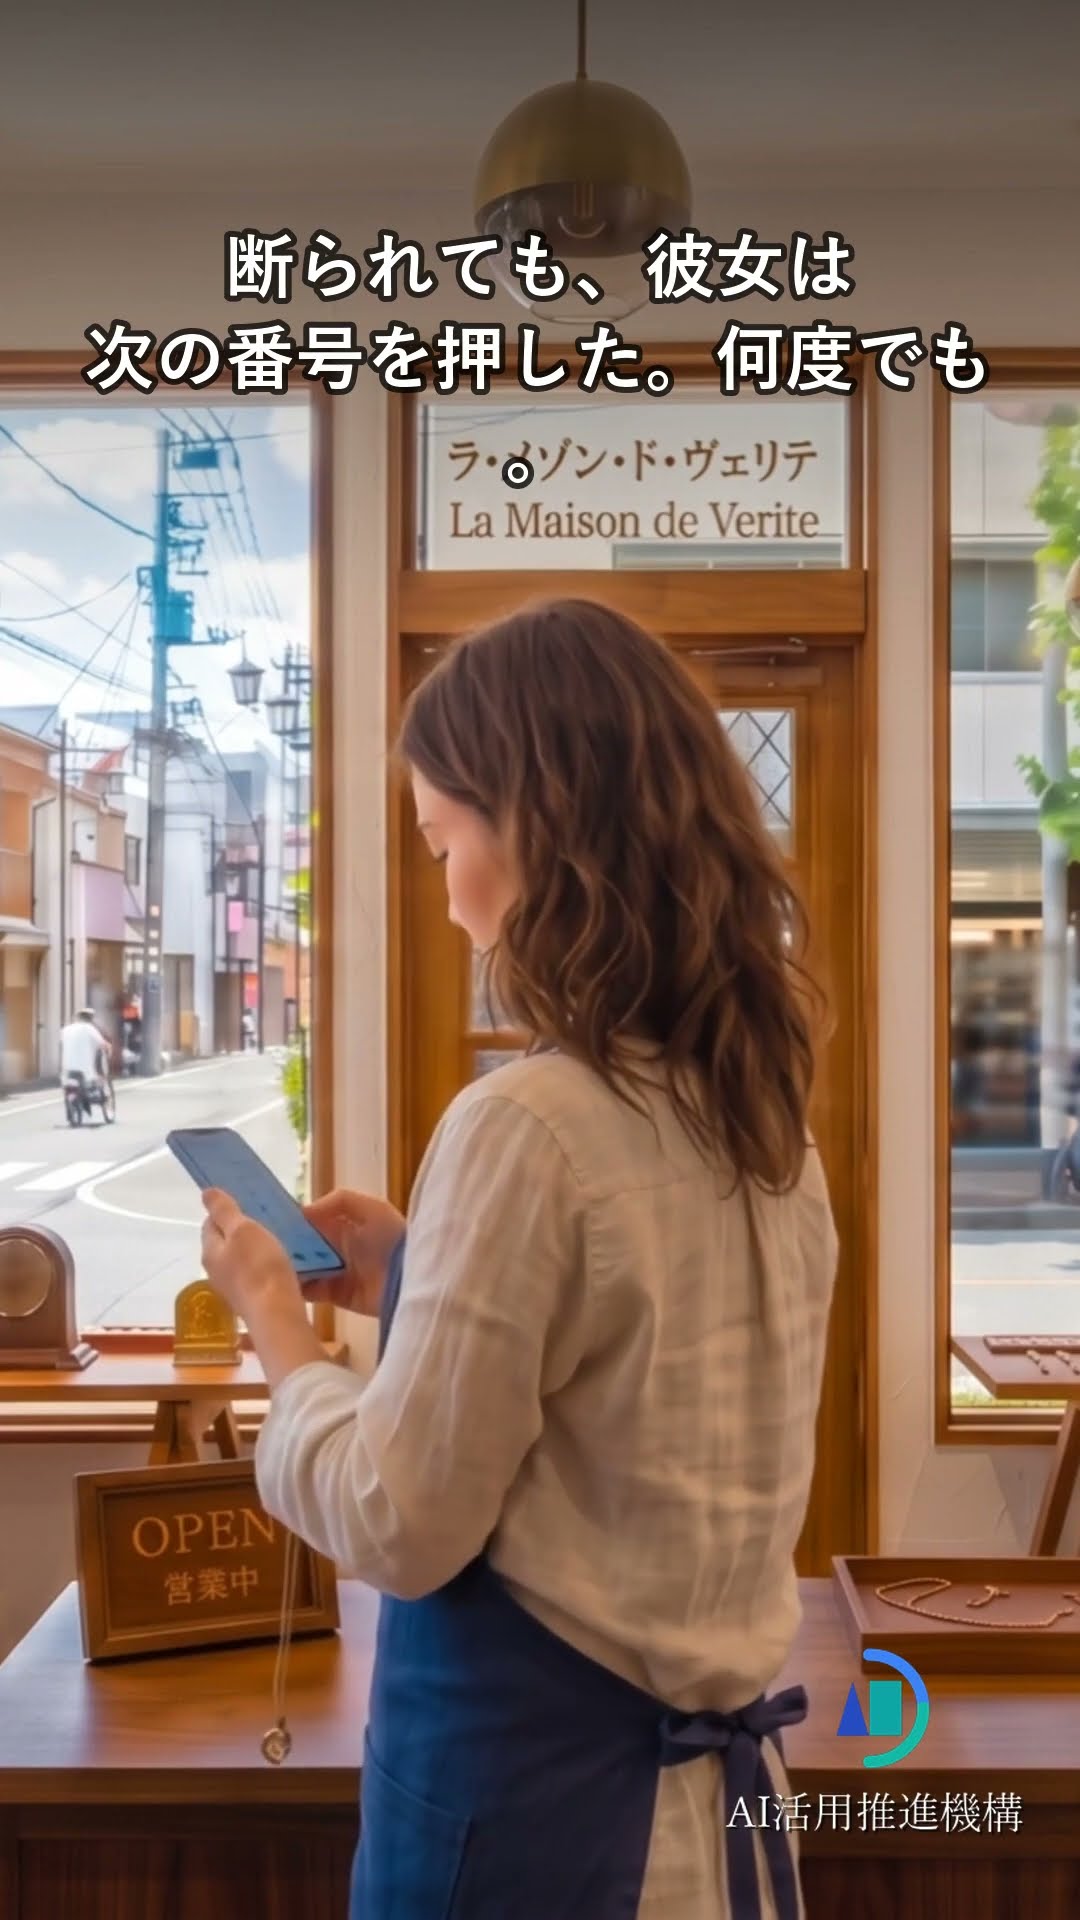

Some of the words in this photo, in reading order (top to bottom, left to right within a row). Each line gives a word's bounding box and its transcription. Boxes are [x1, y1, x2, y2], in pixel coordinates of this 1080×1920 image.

[449, 501, 494, 538] La
[504, 501, 640, 538] Maison
[653, 500, 699, 538] de
[710, 501, 819, 538] Verite
[131, 1507, 275, 1558] OPEN
[163, 1564, 260, 1607] 営業中
